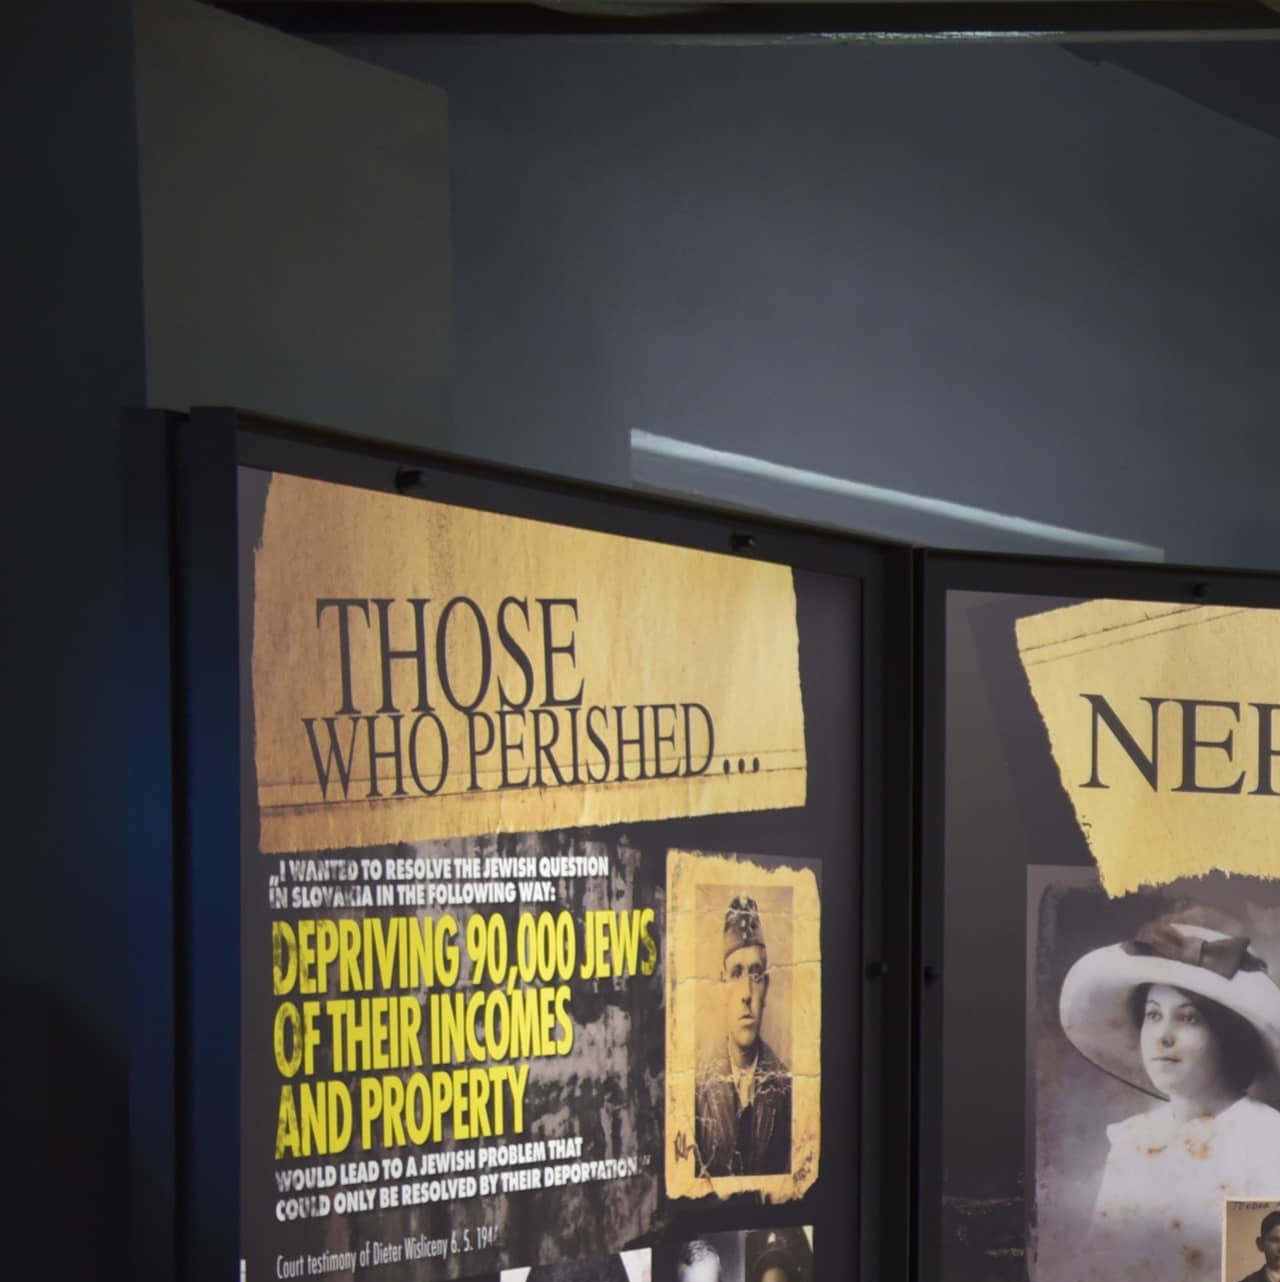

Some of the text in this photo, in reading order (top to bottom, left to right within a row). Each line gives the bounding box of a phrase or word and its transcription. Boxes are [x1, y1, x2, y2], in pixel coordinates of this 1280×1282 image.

[316, 596, 584, 715] THOSE
[302, 703, 761, 800] WHO PERISHED...
[269, 881, 556, 909] IN SLOVAKIA IN THE FOLLOWING WAY:
[289, 859, 359, 882] WANTED
[361, 859, 382, 881] TO
[386, 858, 451, 880] RESOLVE
[454, 857, 481, 879] THE
[483, 856, 537, 879] JEWISH
[538, 856, 609, 878] QUESTION
[271, 909, 658, 996] DEPRIVING 90,000 JEWS
[273, 986, 574, 1078] OF THEIR INCOMES
[275, 1064, 529, 1159] AND PROPERTY
[275, 1137, 583, 1192] WOULD LEAD TO A JEWISH PROBLEM THAT
[275, 1195, 330, 1222] COULD
[333, 1188, 377, 1214] ONLY
[379, 1186, 399, 1209] BE
[402, 1177, 476, 1205] RESOLVED
[479, 1174, 499, 1196] BY
[501, 1169, 541, 1193] THEIR
[276, 1255, 304, 1279] Court
[307, 1250, 356, 1274] testimony
[359, 1241, 371, 1267] of
[373, 1241, 402, 1265] Dieter
[404, 1234, 448, 1260] Wisliceny
[451, 1230, 461, 1254] 6.
[463, 1228, 473, 1251] 5.
